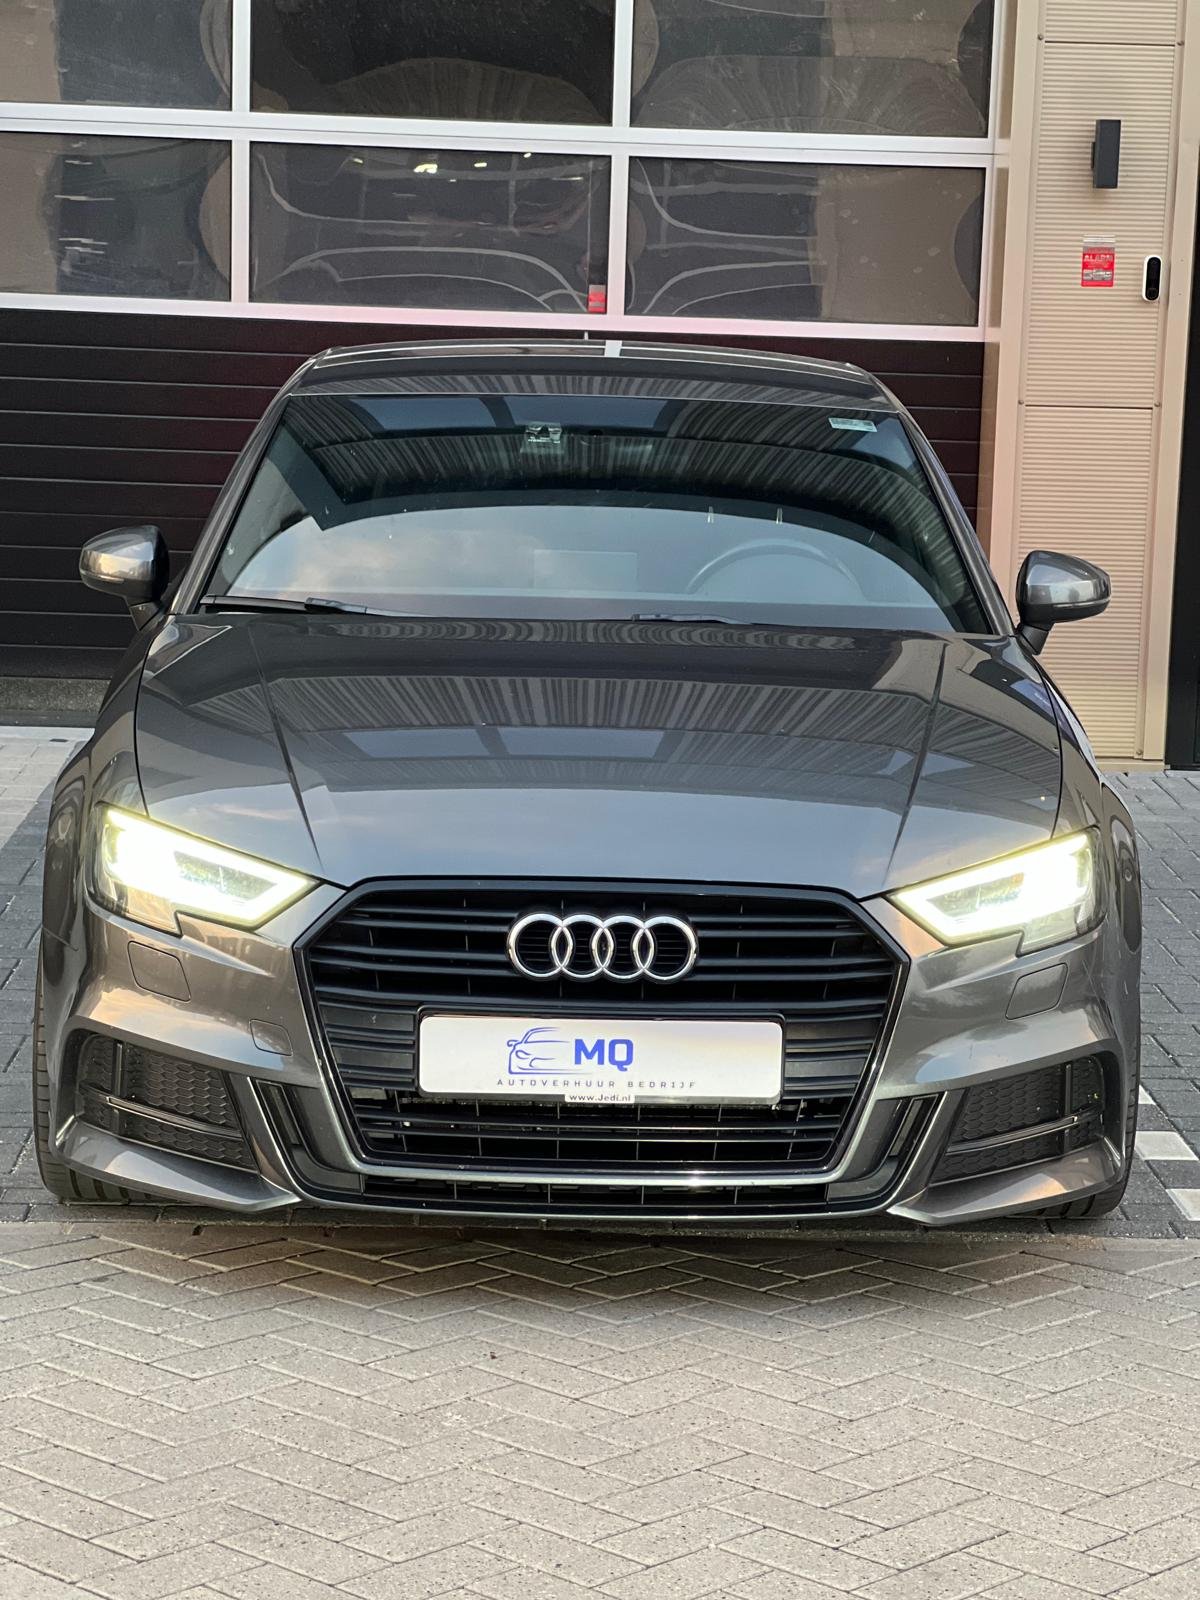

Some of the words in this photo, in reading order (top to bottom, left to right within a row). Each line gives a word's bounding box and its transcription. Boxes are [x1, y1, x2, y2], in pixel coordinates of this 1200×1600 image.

[575, 1039, 634, 1072] MQ
[497, 1079, 616, 1088] AUTOVERHUUR
[628, 1081, 696, 1089] BEDRIJF
[569, 1094, 631, 1102] www.Jedi.nl
